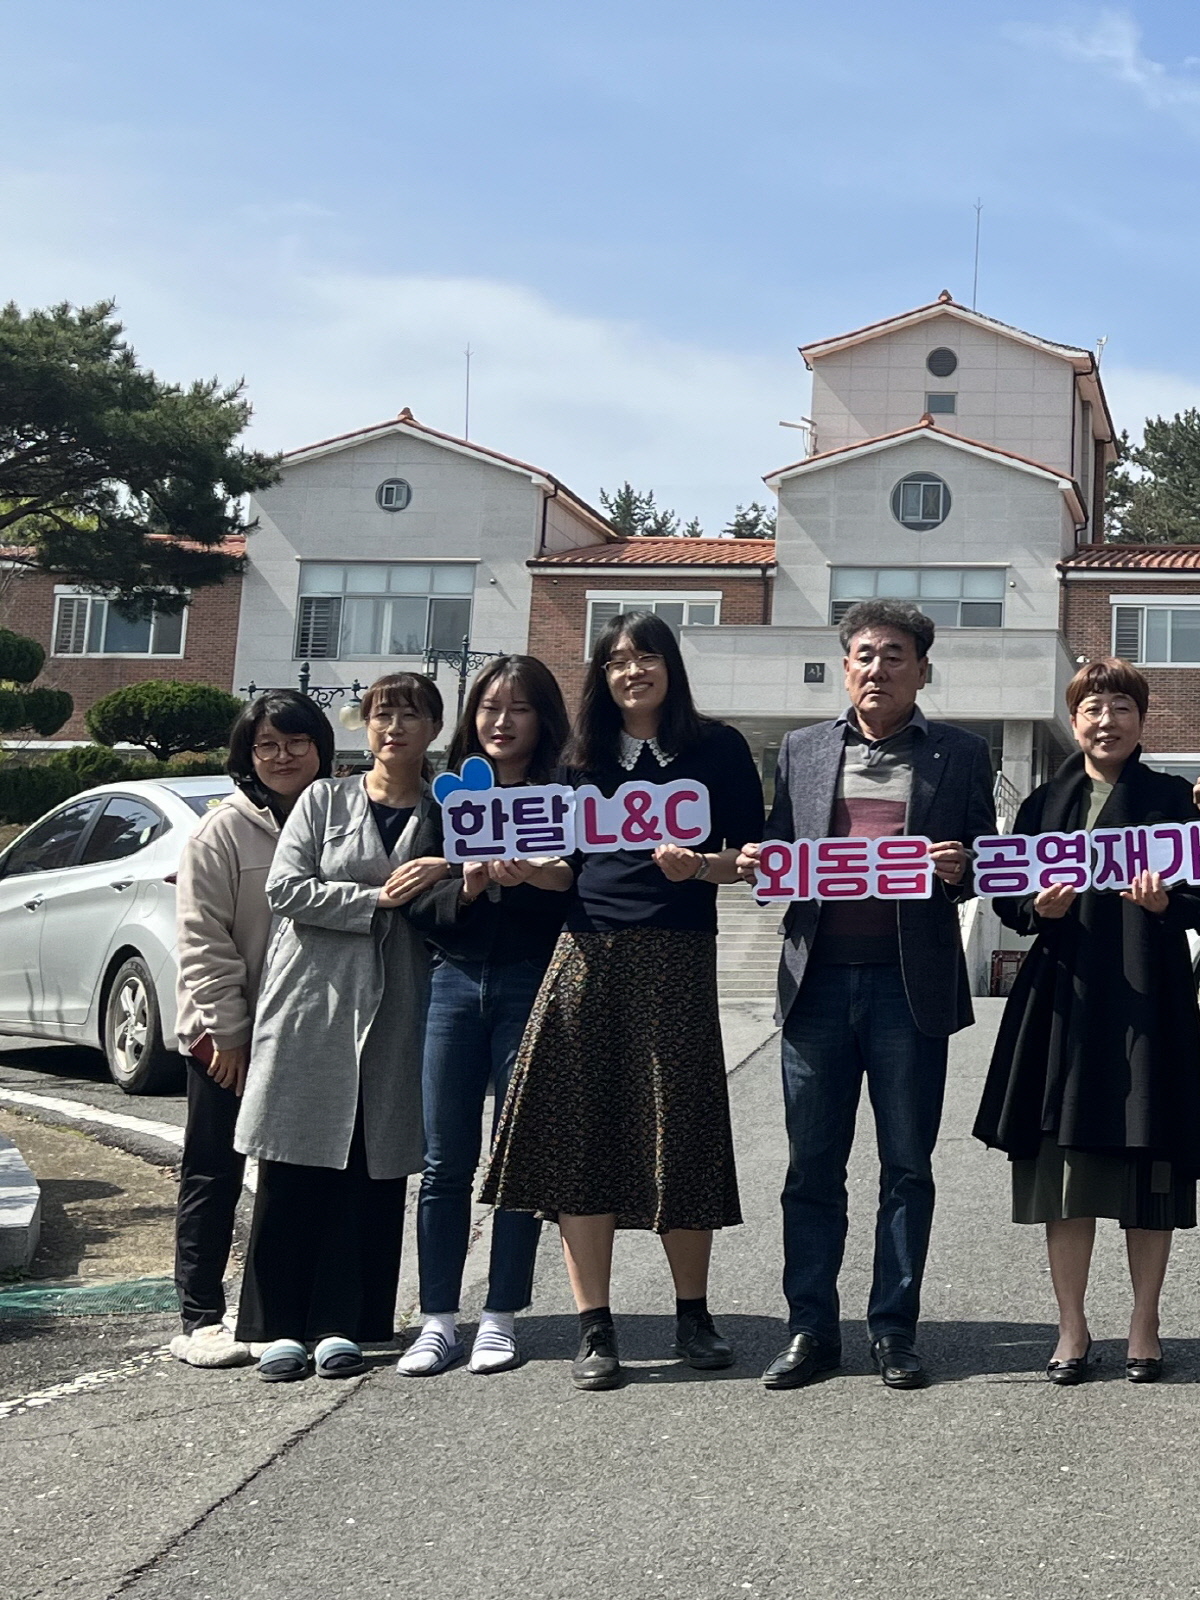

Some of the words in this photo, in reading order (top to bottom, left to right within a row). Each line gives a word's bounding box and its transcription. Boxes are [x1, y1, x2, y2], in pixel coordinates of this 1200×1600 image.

[448, 796, 569, 857] 한탈
[584, 790, 703, 845] L&C
[757, 841, 928, 898] 외동읍
